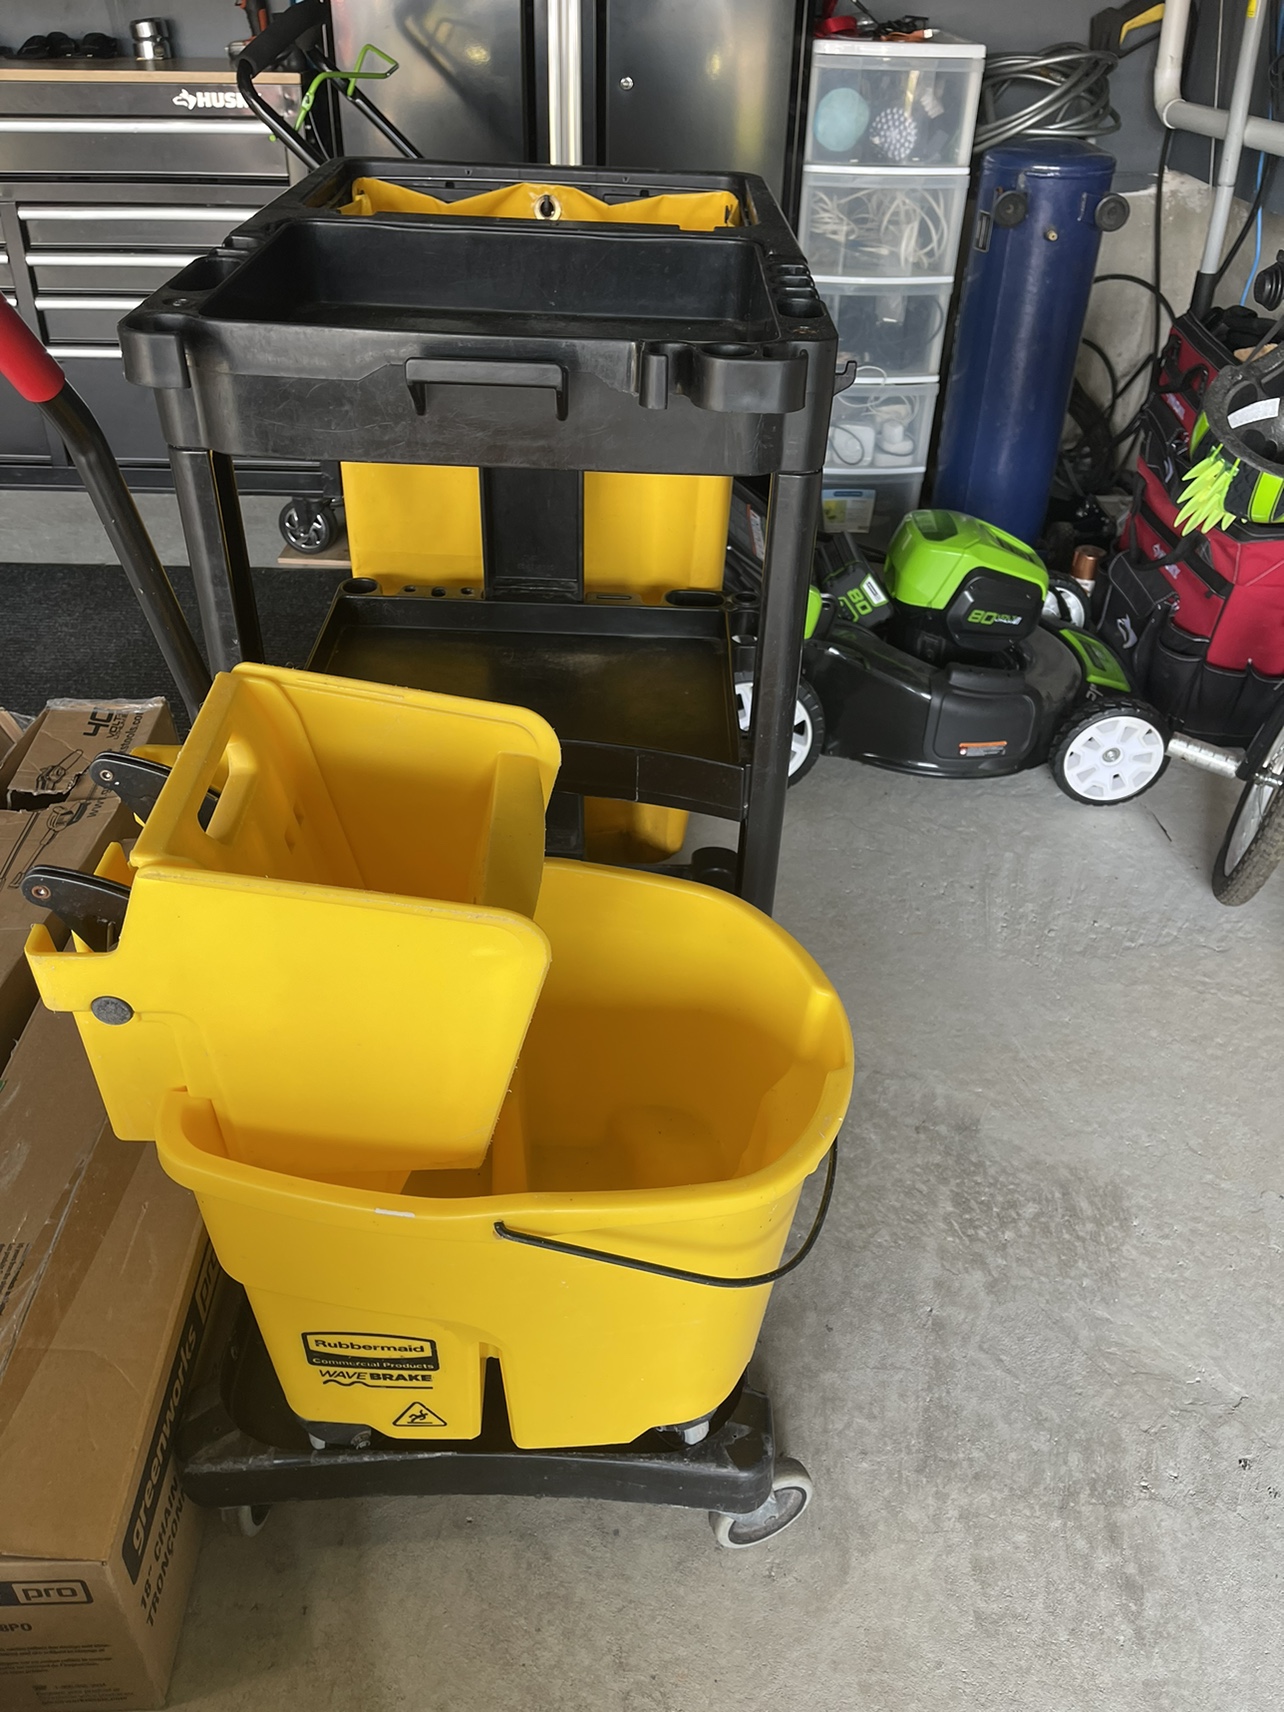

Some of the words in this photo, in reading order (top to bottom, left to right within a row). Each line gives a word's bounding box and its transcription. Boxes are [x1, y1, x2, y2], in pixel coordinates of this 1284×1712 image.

[196, 91, 250, 108] HUSK
[847, 588, 873, 616] 80
[314, 1339, 425, 1353] Rubbermaid
[312, 1357, 380, 1368] Commercial
[382, 1361, 434, 1370] Products
[319, 1369, 368, 1380] WAVE
[369, 1372, 433, 1382] BRAKE
[133, 1323, 197, 1557] greenworks
[154, 1475, 178, 1563] CHAIN
[21, 1586, 78, 1601] pro
